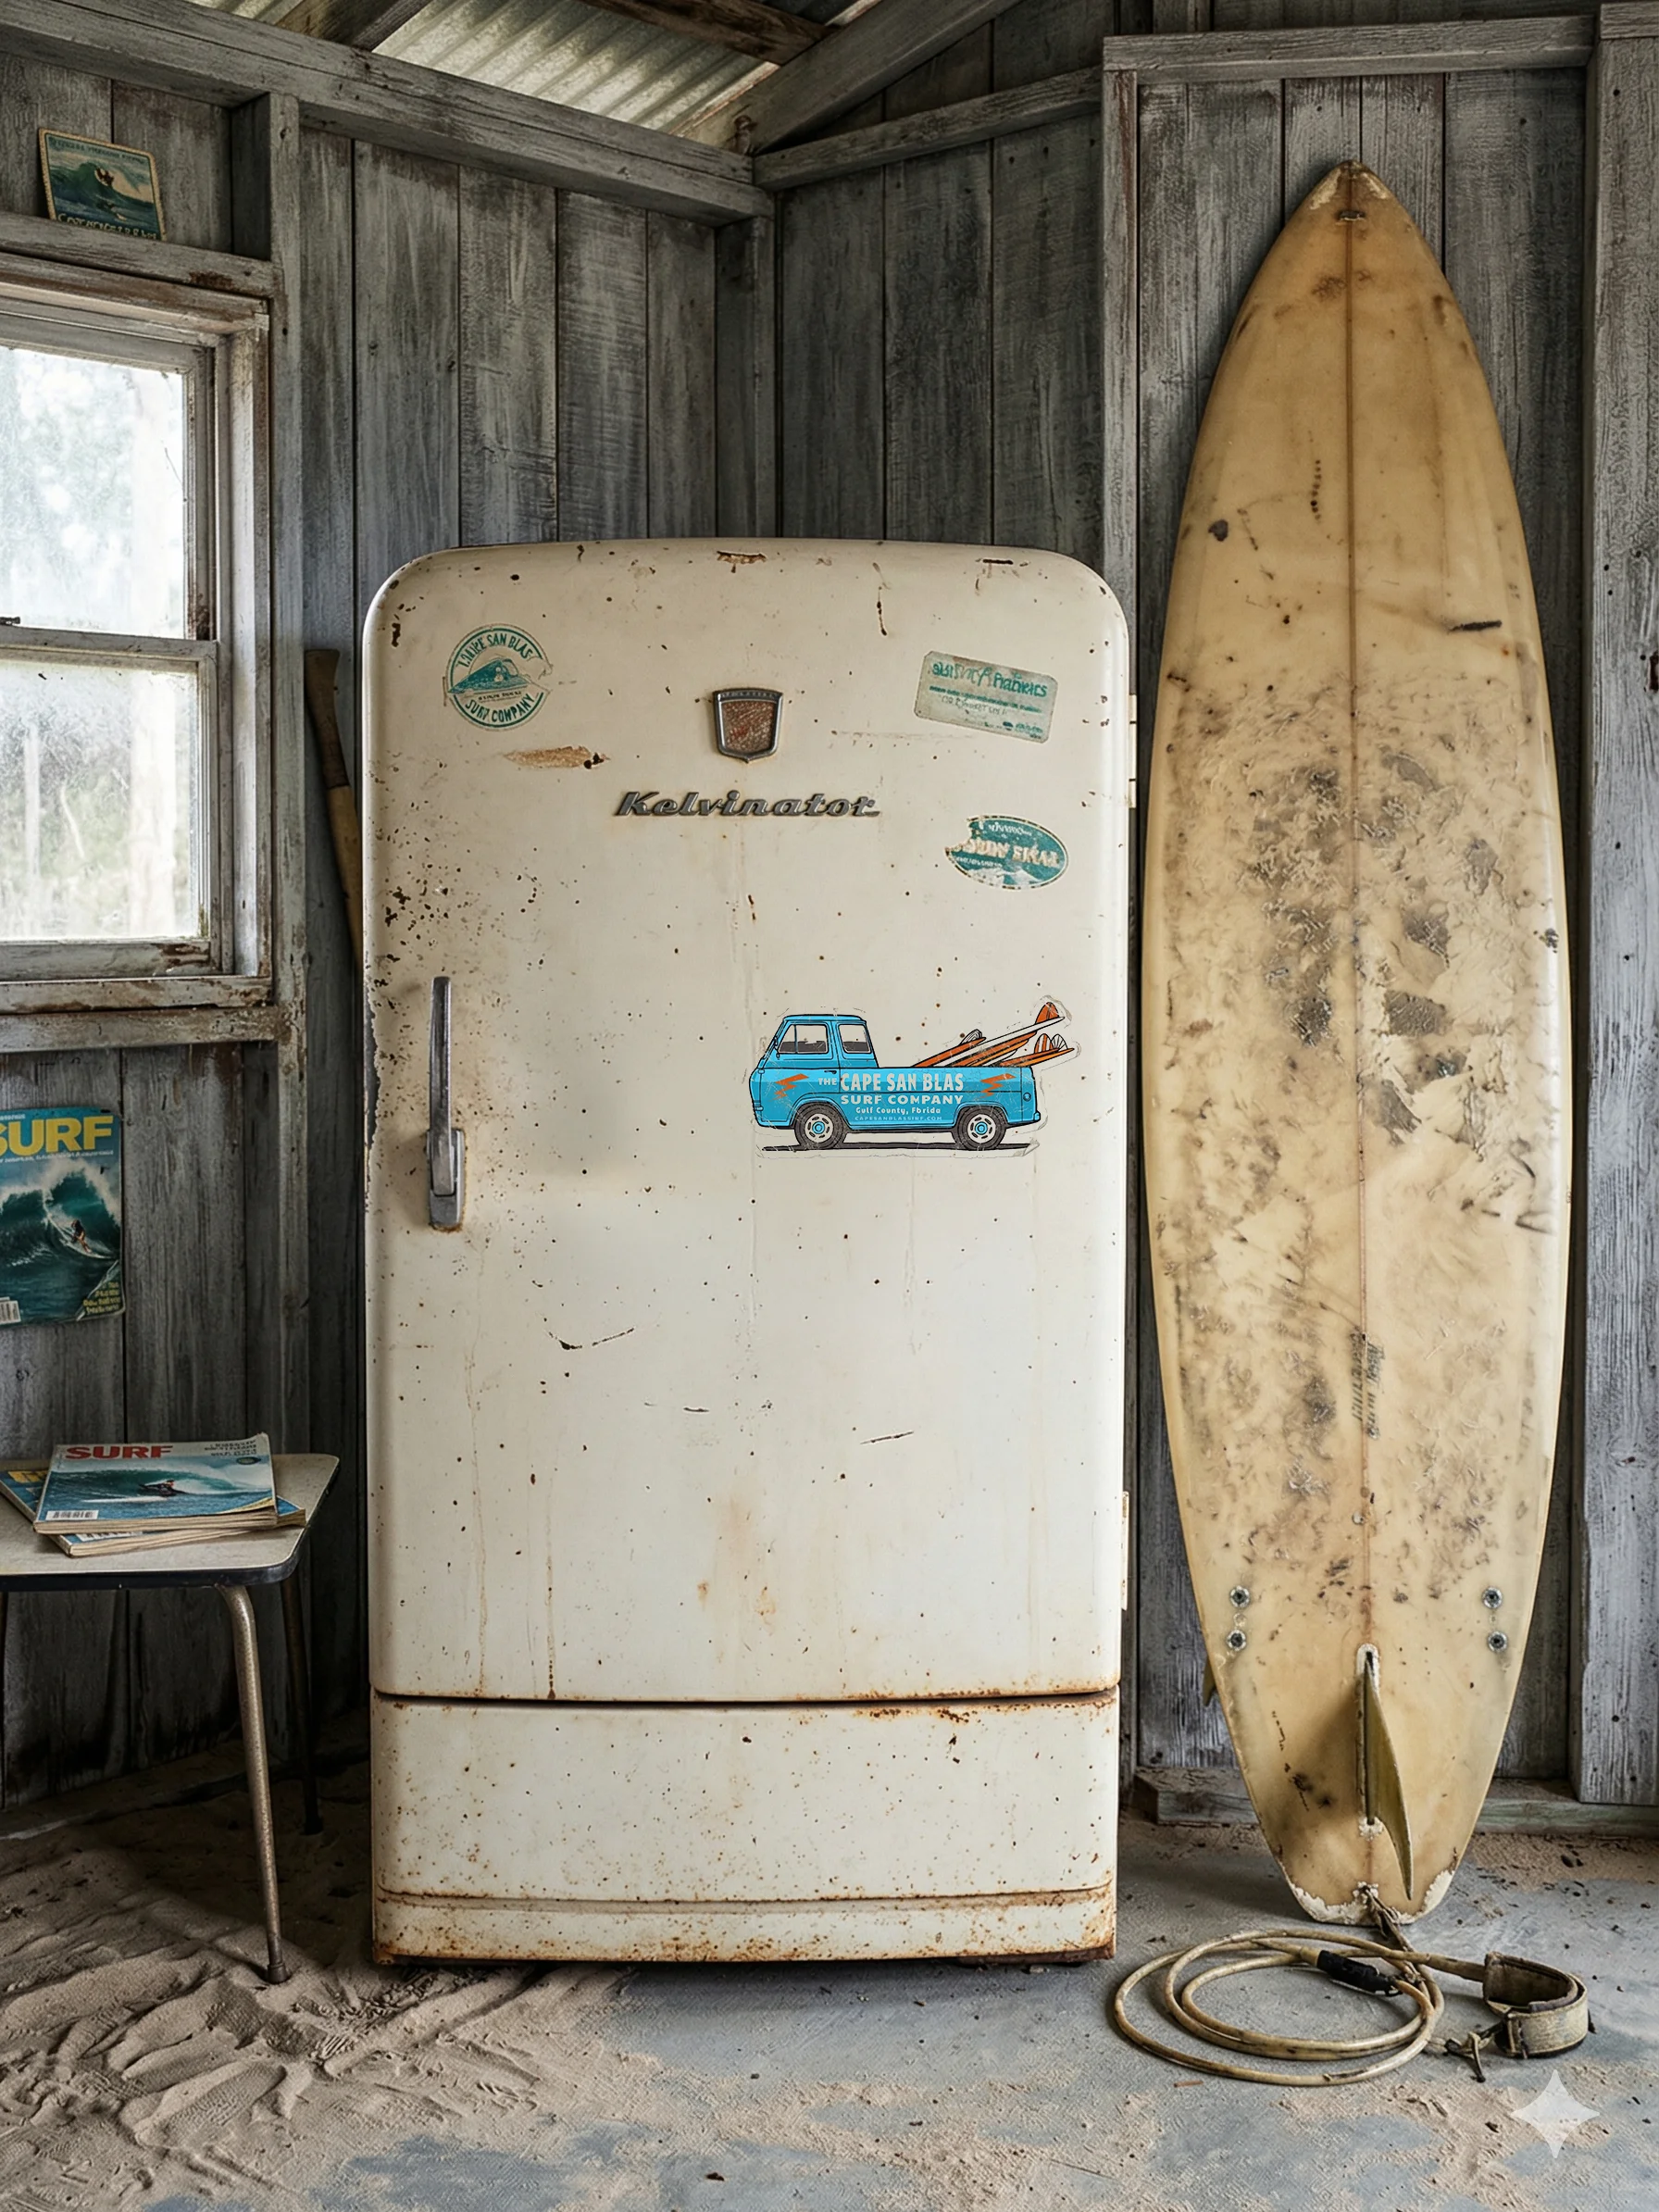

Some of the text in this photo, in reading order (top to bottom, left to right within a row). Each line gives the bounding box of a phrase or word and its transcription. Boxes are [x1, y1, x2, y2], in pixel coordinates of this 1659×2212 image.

[486, 632, 507, 647] SAN
[614, 790, 879, 817] Kelvinator
[817, 1073, 964, 1092] THE CAPE SAN BLAS
[841, 1095, 964, 1105] SURF COMPANY
[876, 1106, 909, 1115] County,
[0, 1116, 113, 1156] URF
[66, 1445, 173, 1459] SURF
